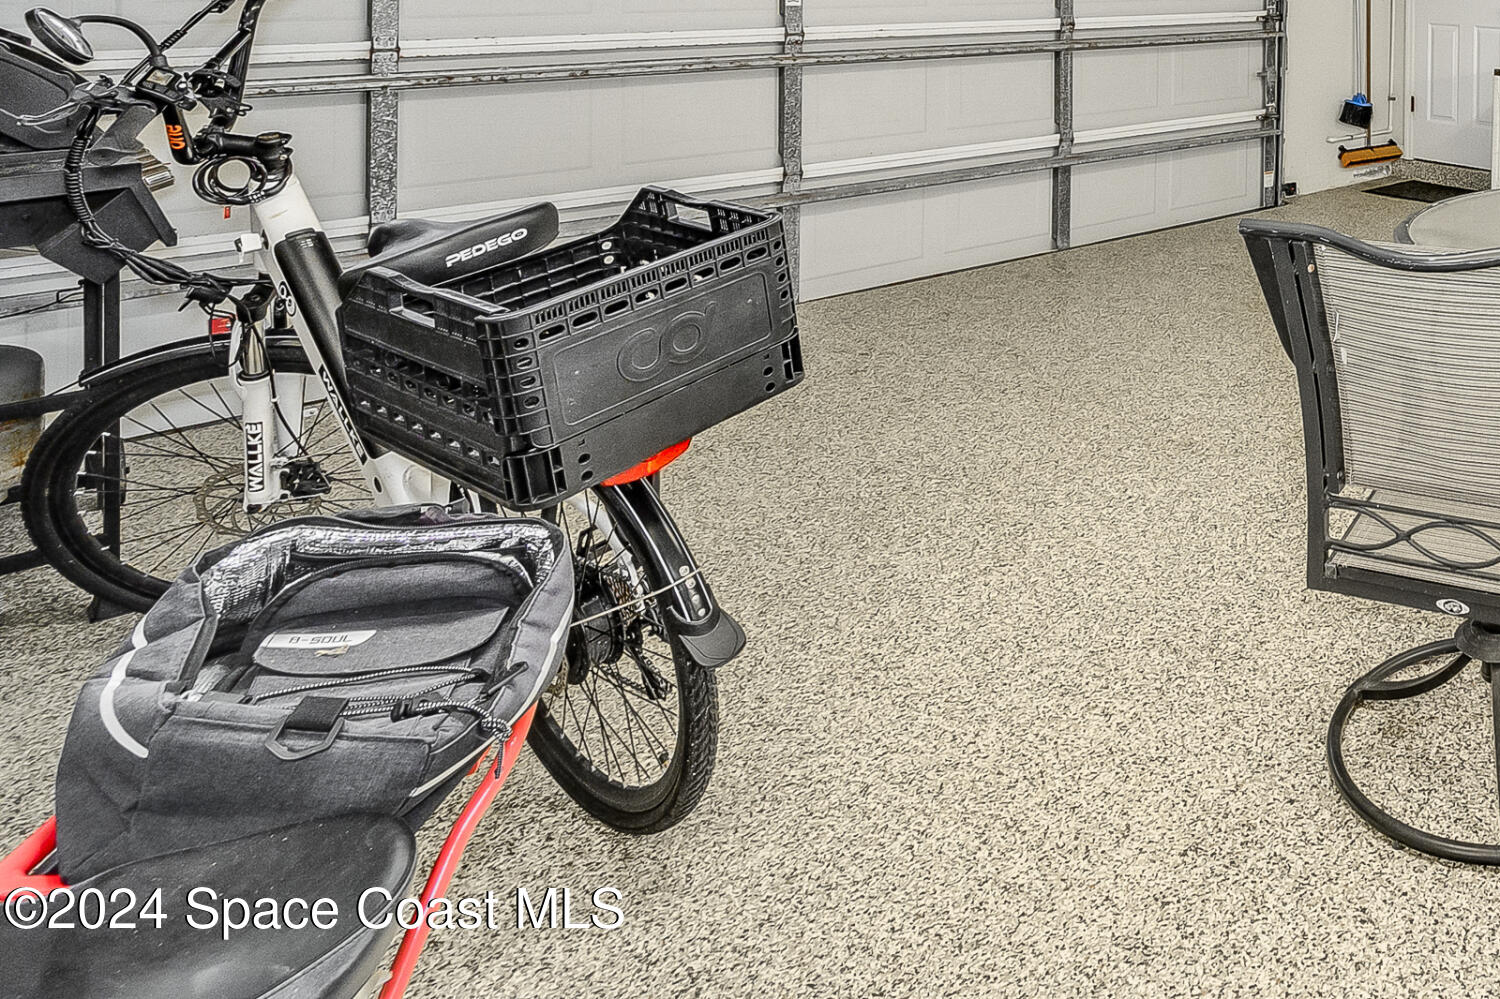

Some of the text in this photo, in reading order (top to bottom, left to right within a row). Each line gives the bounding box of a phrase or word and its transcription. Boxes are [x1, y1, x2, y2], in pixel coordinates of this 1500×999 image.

[445, 228, 528, 268] PEDEGO
[322, 370, 365, 459] WALLKE
[245, 422, 265, 492] WALLKE
